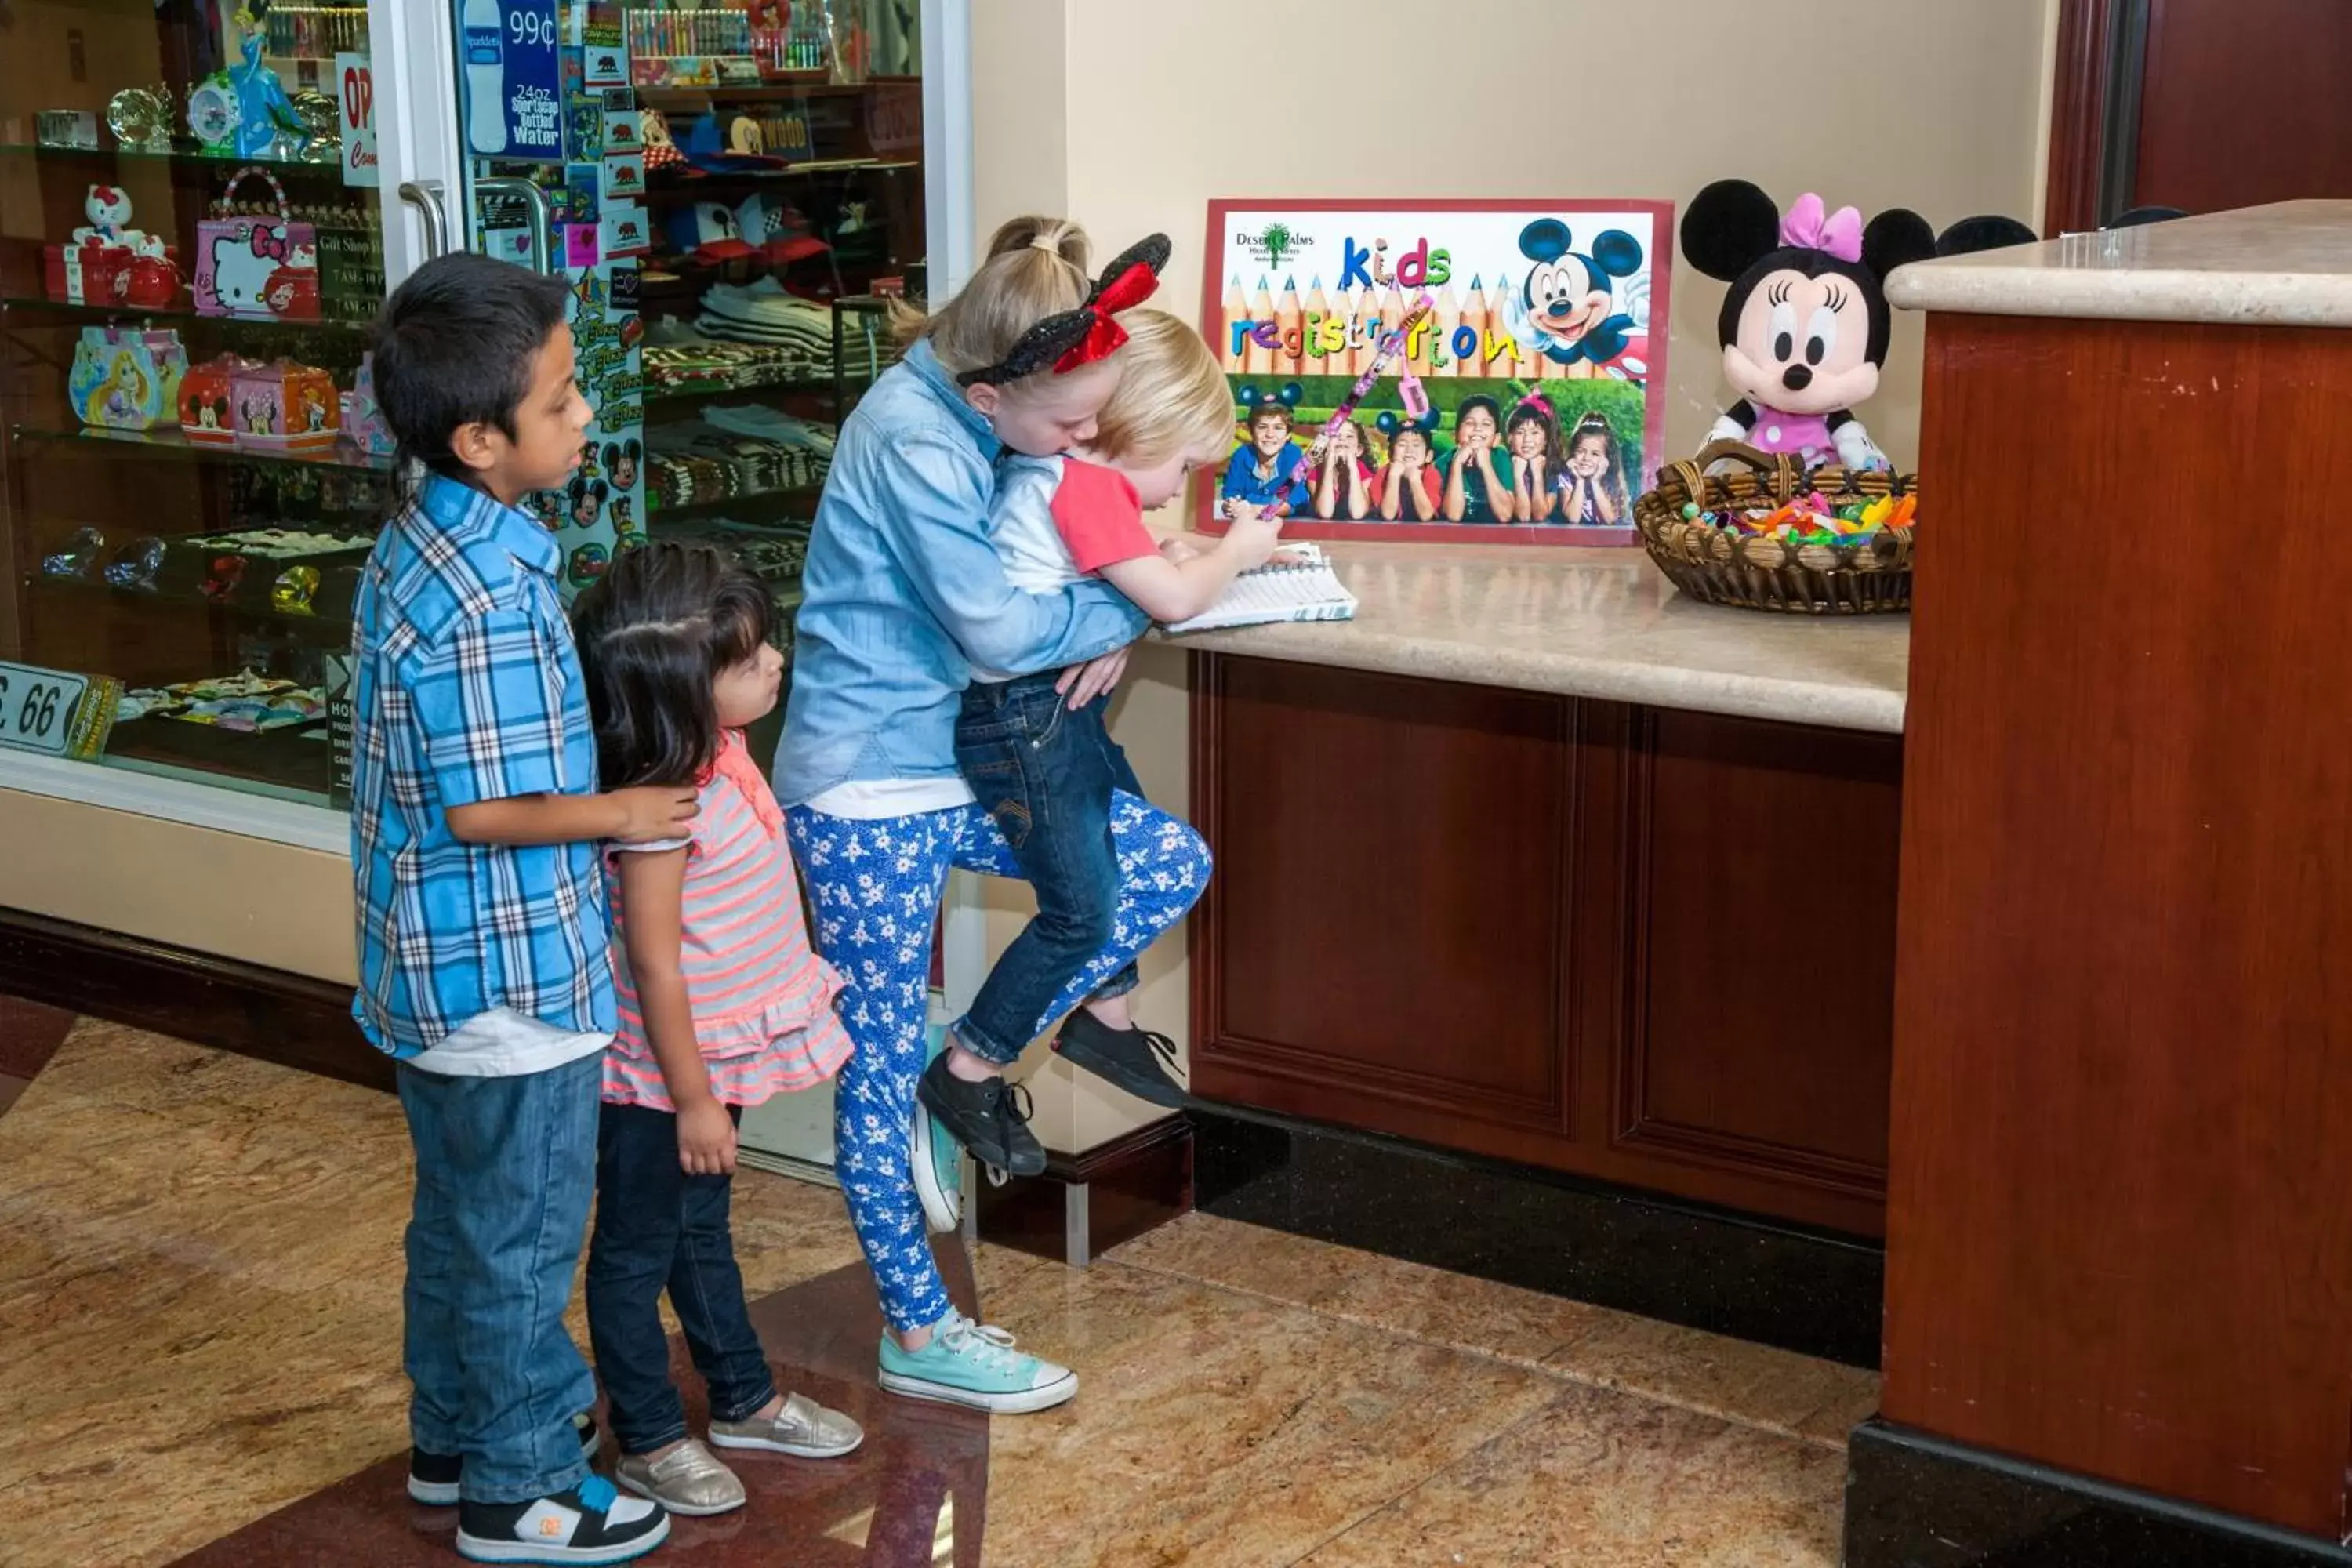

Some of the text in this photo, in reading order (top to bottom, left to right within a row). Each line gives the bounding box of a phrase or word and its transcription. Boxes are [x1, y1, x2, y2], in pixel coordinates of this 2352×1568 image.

[510, 10, 554, 53] 99¢
[517, 84, 551, 101] 24oz
[513, 125, 559, 146] Water
[1341, 236, 1452, 289] kids
[19, 683, 60, 737] 66
